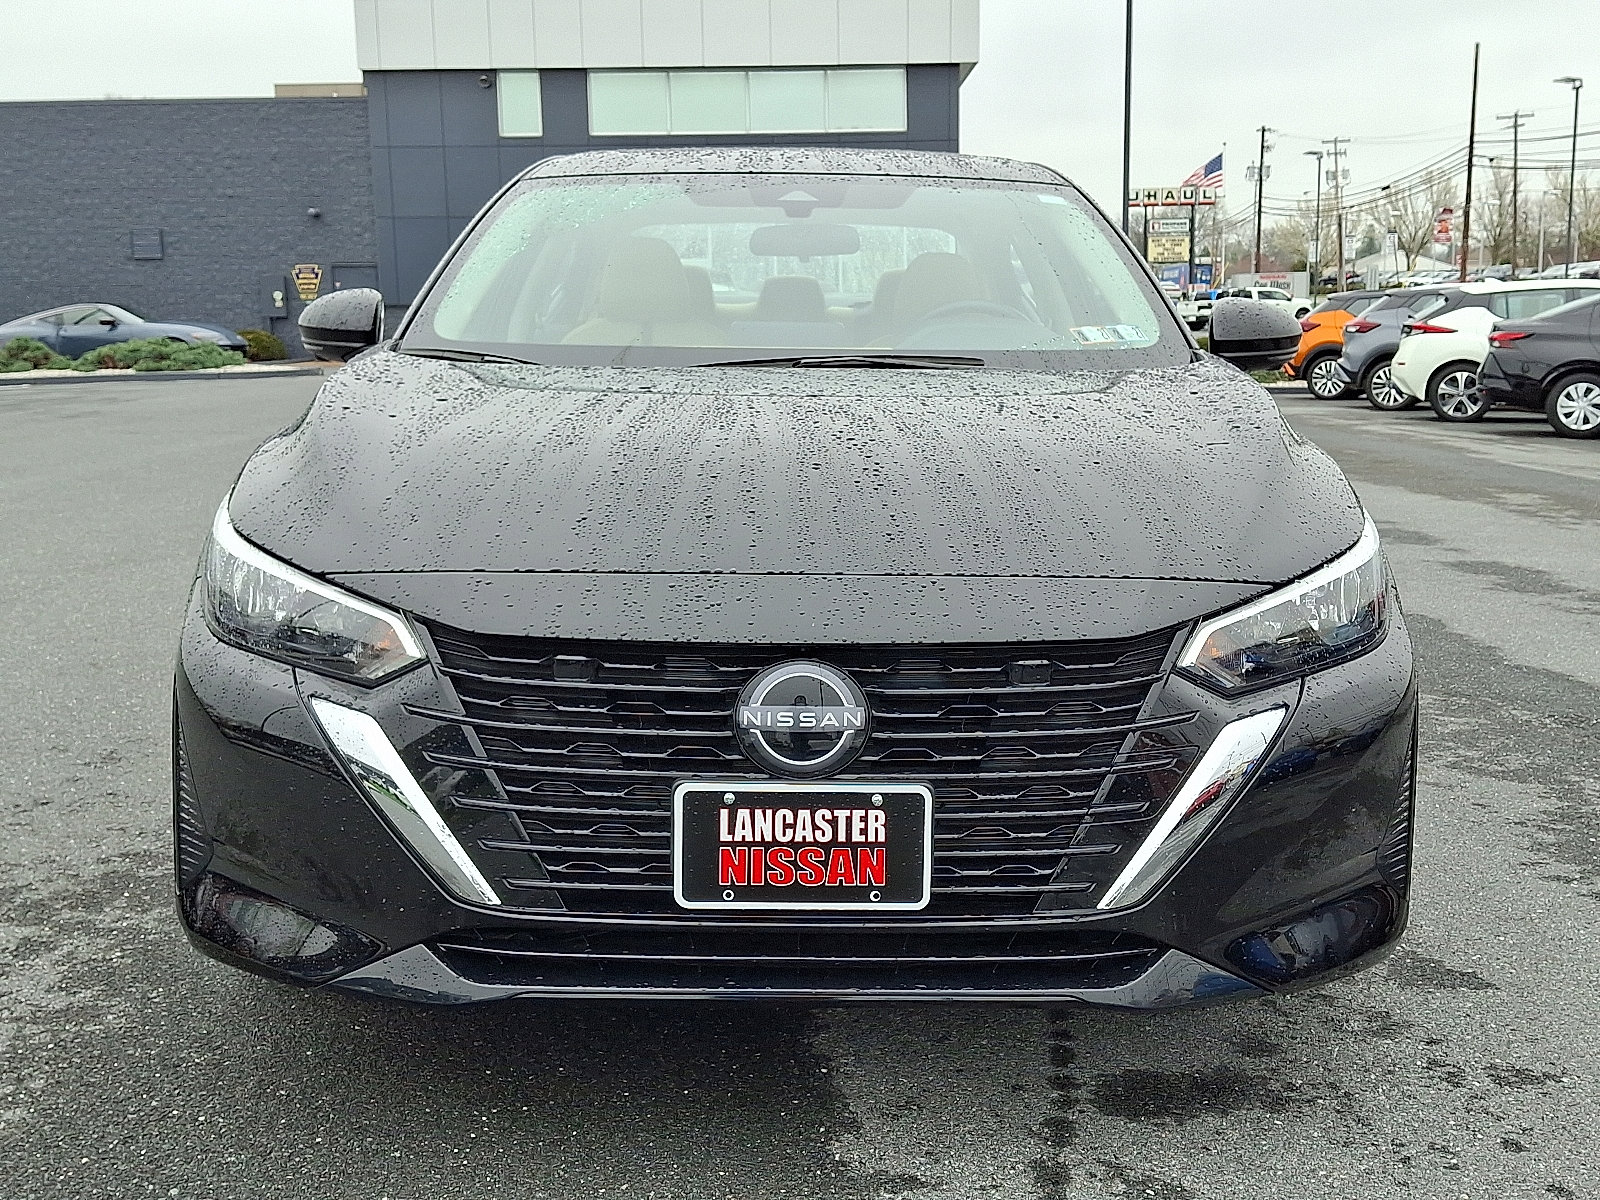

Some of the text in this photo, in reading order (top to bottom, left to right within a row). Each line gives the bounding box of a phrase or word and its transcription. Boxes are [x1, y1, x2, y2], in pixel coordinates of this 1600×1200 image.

[743, 710, 862, 727] NISSAN
[718, 808, 886, 843] LANCASTER
[718, 846, 886, 887] NISSAN
